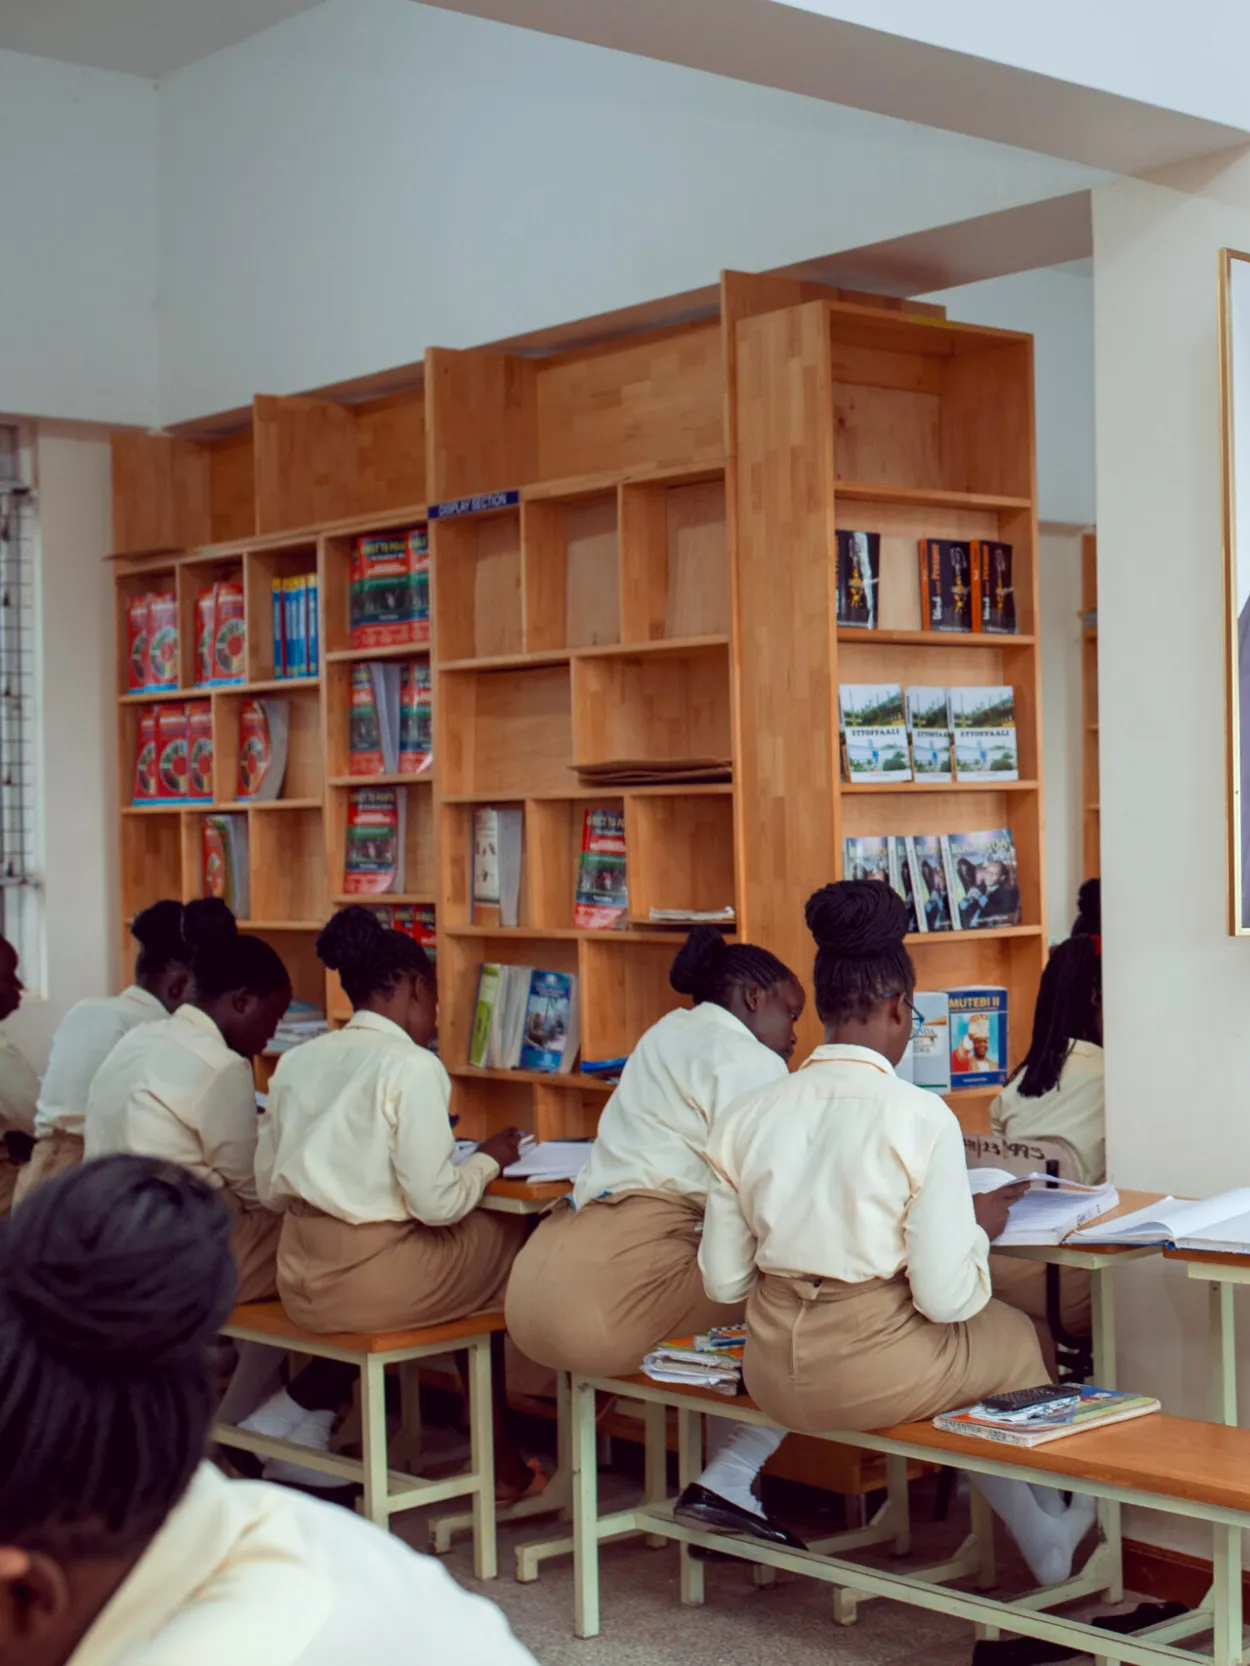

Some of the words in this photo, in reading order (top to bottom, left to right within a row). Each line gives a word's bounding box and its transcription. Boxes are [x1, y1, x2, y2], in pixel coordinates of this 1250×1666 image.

[439, 500, 469, 516] DISPLAY
[472, 494, 506, 511] SECTION
[948, 997, 991, 1009] MUTEBI
[992, 996, 1000, 1008] II
